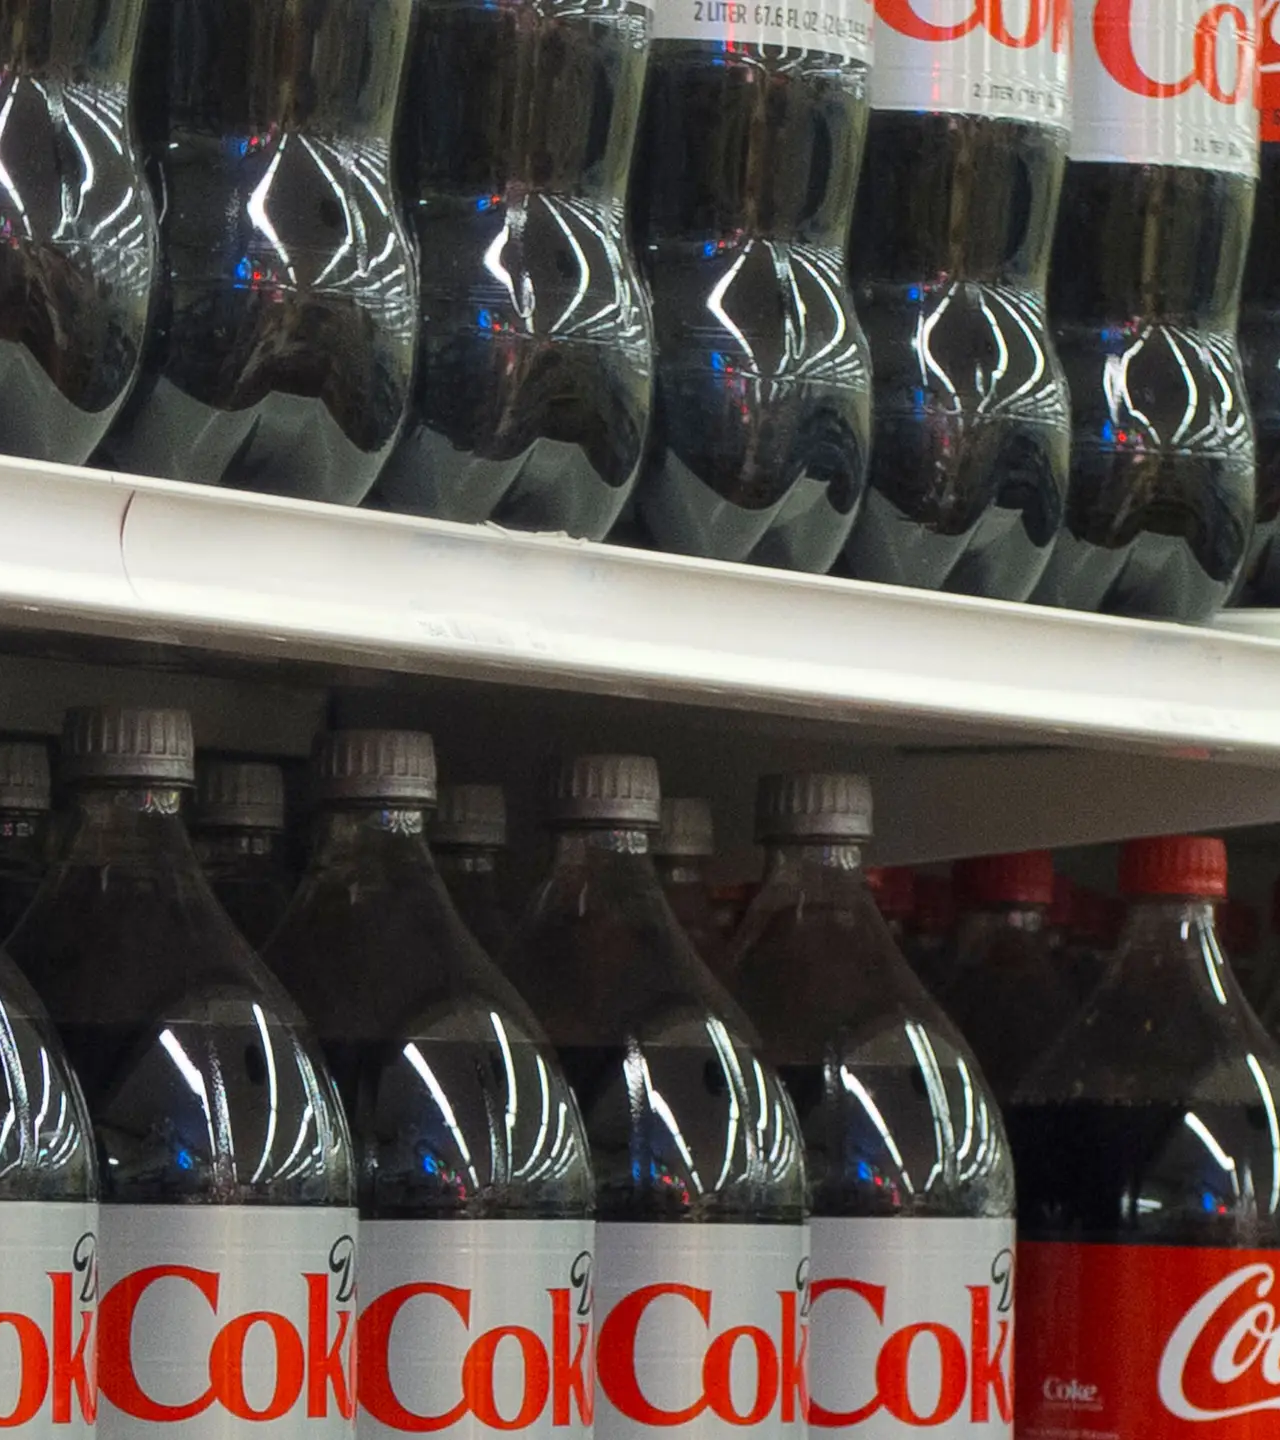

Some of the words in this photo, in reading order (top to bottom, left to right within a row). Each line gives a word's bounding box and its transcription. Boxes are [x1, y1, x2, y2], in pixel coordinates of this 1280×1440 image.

[693, 1, 702, 22] 2
[707, 2, 748, 25] LITER
[754, 6, 784, 28] 67.6
[97, 1263, 358, 1423] Cok
[357, 1281, 594, 1432] Cok
[596, 1281, 808, 1426] Cok
[808, 1277, 1013, 1428] Cok
[1043, 1376, 1098, 1402] Coke
